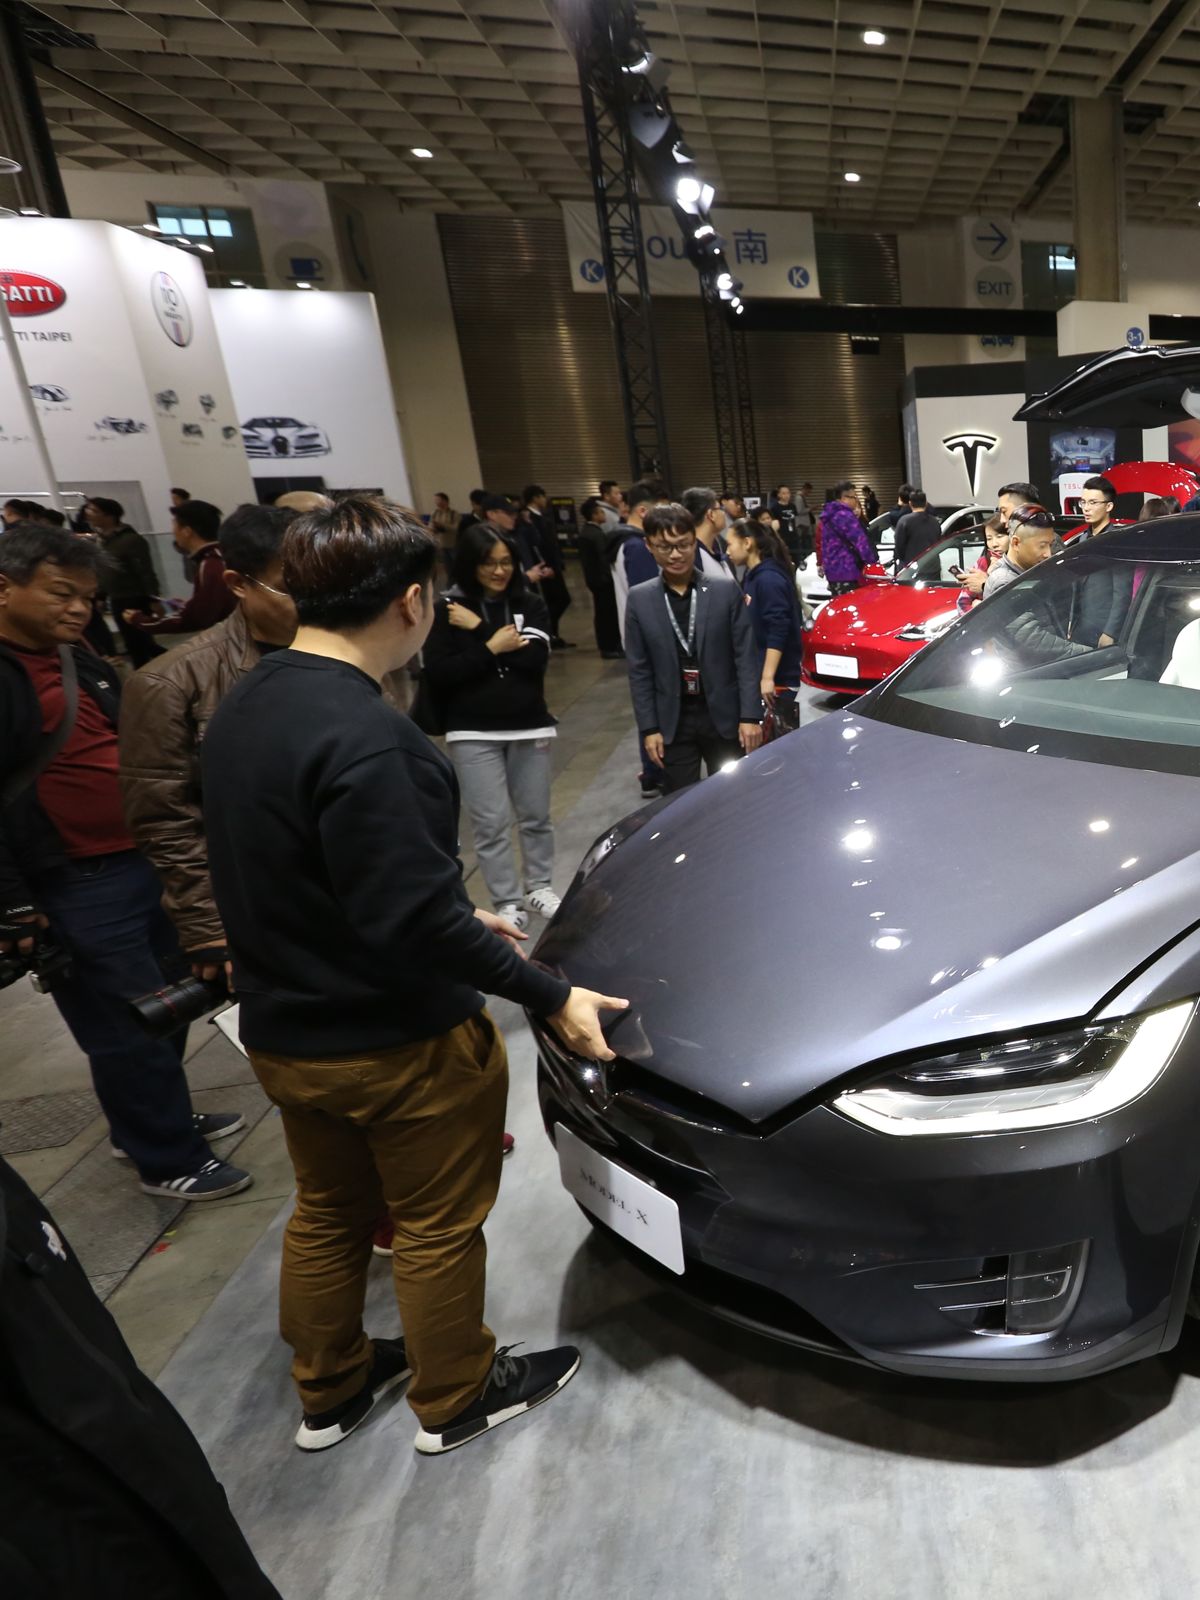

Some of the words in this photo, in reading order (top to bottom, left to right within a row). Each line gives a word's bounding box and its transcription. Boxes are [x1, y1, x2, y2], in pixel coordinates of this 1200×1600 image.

[732, 228, 769, 265] 南
[977, 281, 1012, 295] EXIT
[31, 331, 72, 341] TAIPEI
